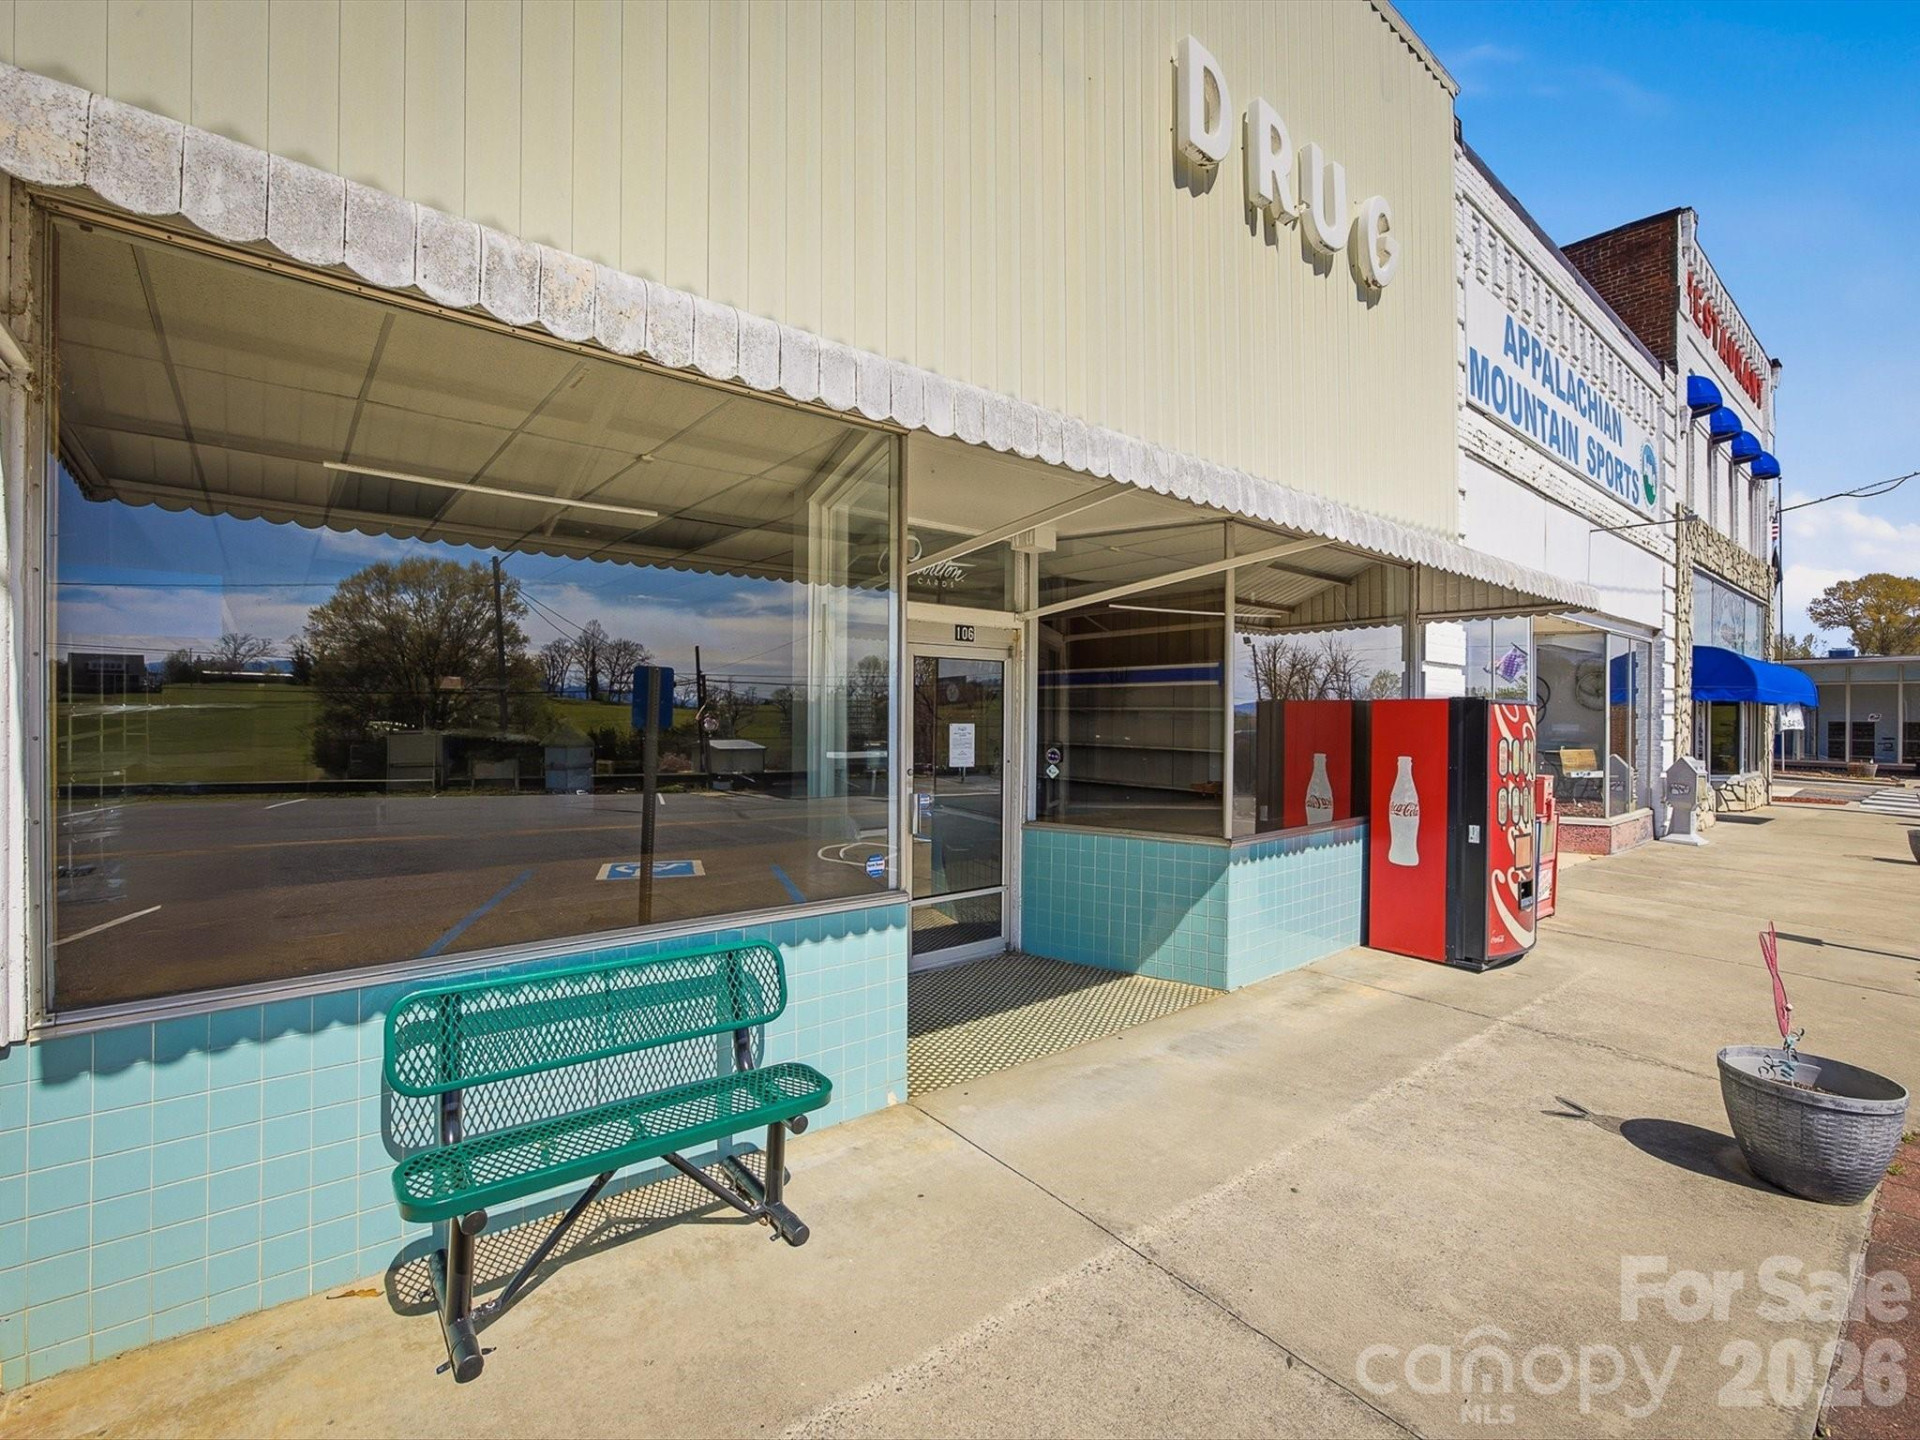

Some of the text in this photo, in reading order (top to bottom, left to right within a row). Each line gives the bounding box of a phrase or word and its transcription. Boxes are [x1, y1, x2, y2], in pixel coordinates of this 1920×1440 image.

[1178, 34, 1399, 288] DRUG
[1469, 346, 1579, 466] MOUNTAIN
[1586, 434, 1640, 505] SPORTS
[1503, 314, 1623, 447] APPALACHIAN
[956, 626, 975, 641] 106
